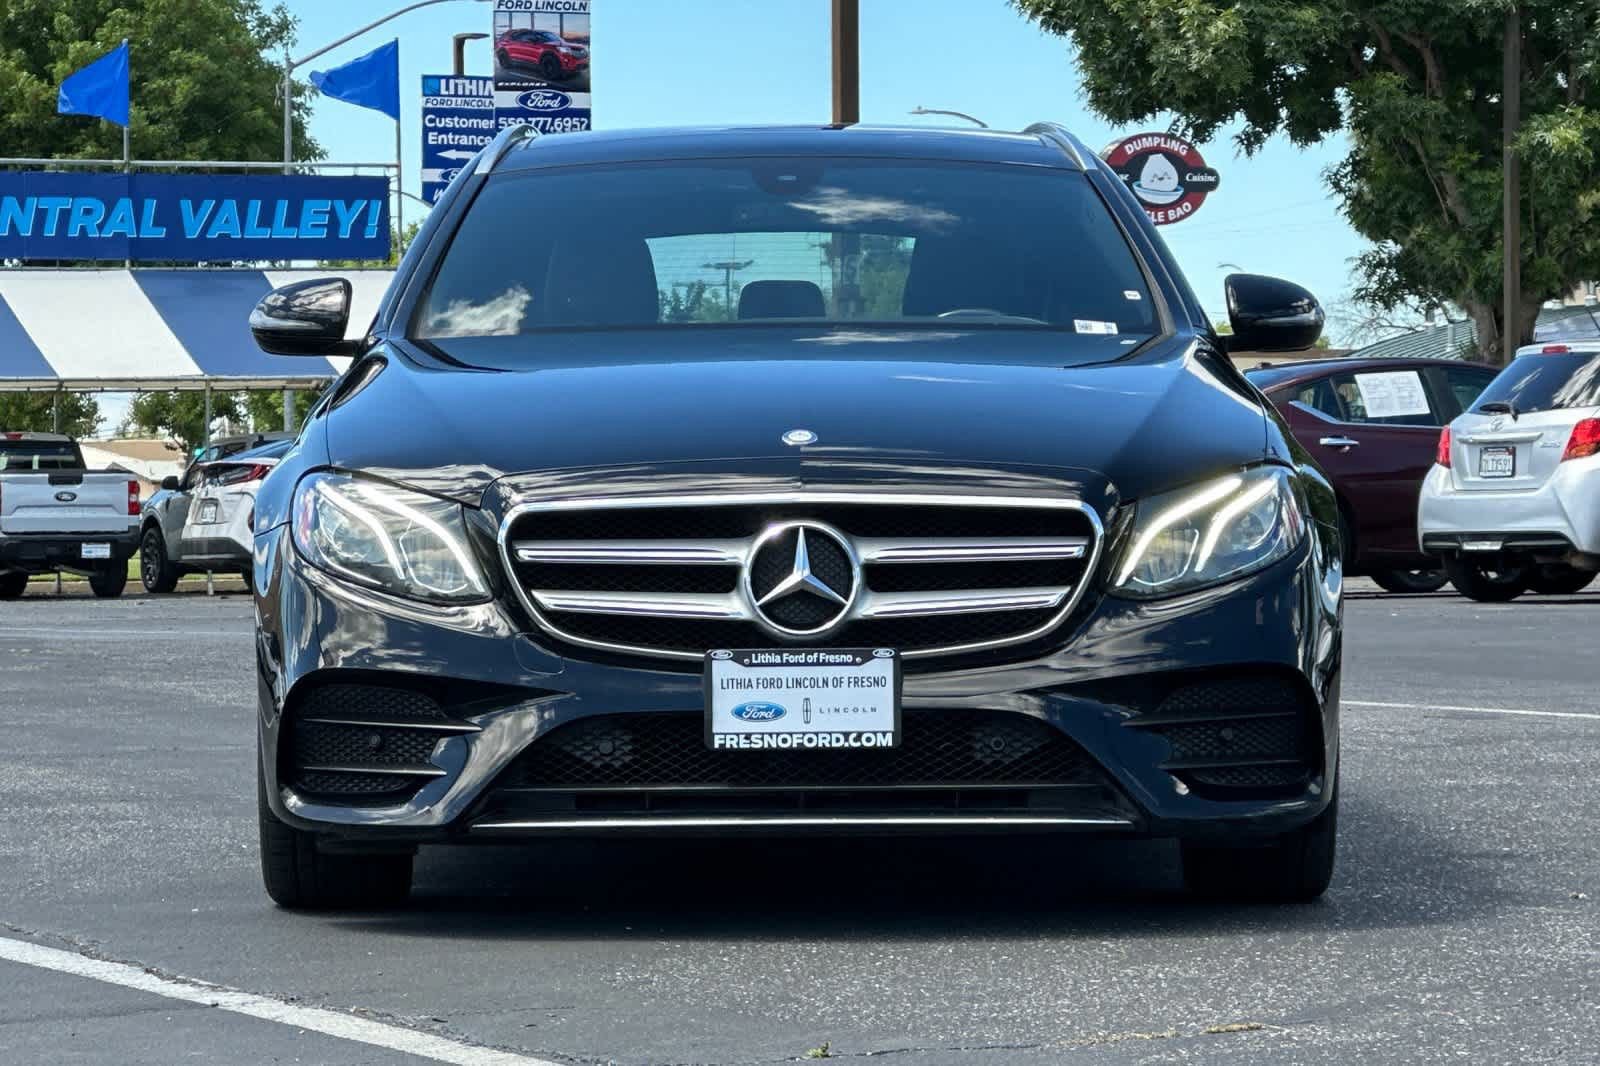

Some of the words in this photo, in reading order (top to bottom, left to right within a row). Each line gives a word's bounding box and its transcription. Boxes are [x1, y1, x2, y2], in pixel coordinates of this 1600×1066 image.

[497, 0, 533, 9] FORD
[535, 0, 588, 11] LINCOLN
[440, 78, 495, 96] LITHIA
[425, 97, 453, 106] FORD
[454, 98, 495, 108] LINCOLN
[527, 92, 562, 107] Ford
[425, 114, 495, 129] Customer
[428, 131, 493, 146] Entrance
[1124, 136, 1188, 156] DUMPLING
[1185, 172, 1217, 182] Cuisine
[180, 198, 382, 239] VALLEY!
[1167, 201, 1192, 221] BAO
[752, 653, 781, 664] Lithia
[783, 653, 806, 663] Ford
[807, 652, 819, 663] of
[819, 652, 853, 663] Fresno
[720, 677, 754, 690] LITHIA
[756, 677, 783, 689] FORD
[786, 676, 829, 689] LINCOLN
[832, 676, 845, 688] OF
[848, 675, 887, 688] FRESNO
[742, 703, 775, 720] Ford
[819, 706, 878, 714] LINCOLN
[713, 732, 893, 749] FRESNOFORD.COM
